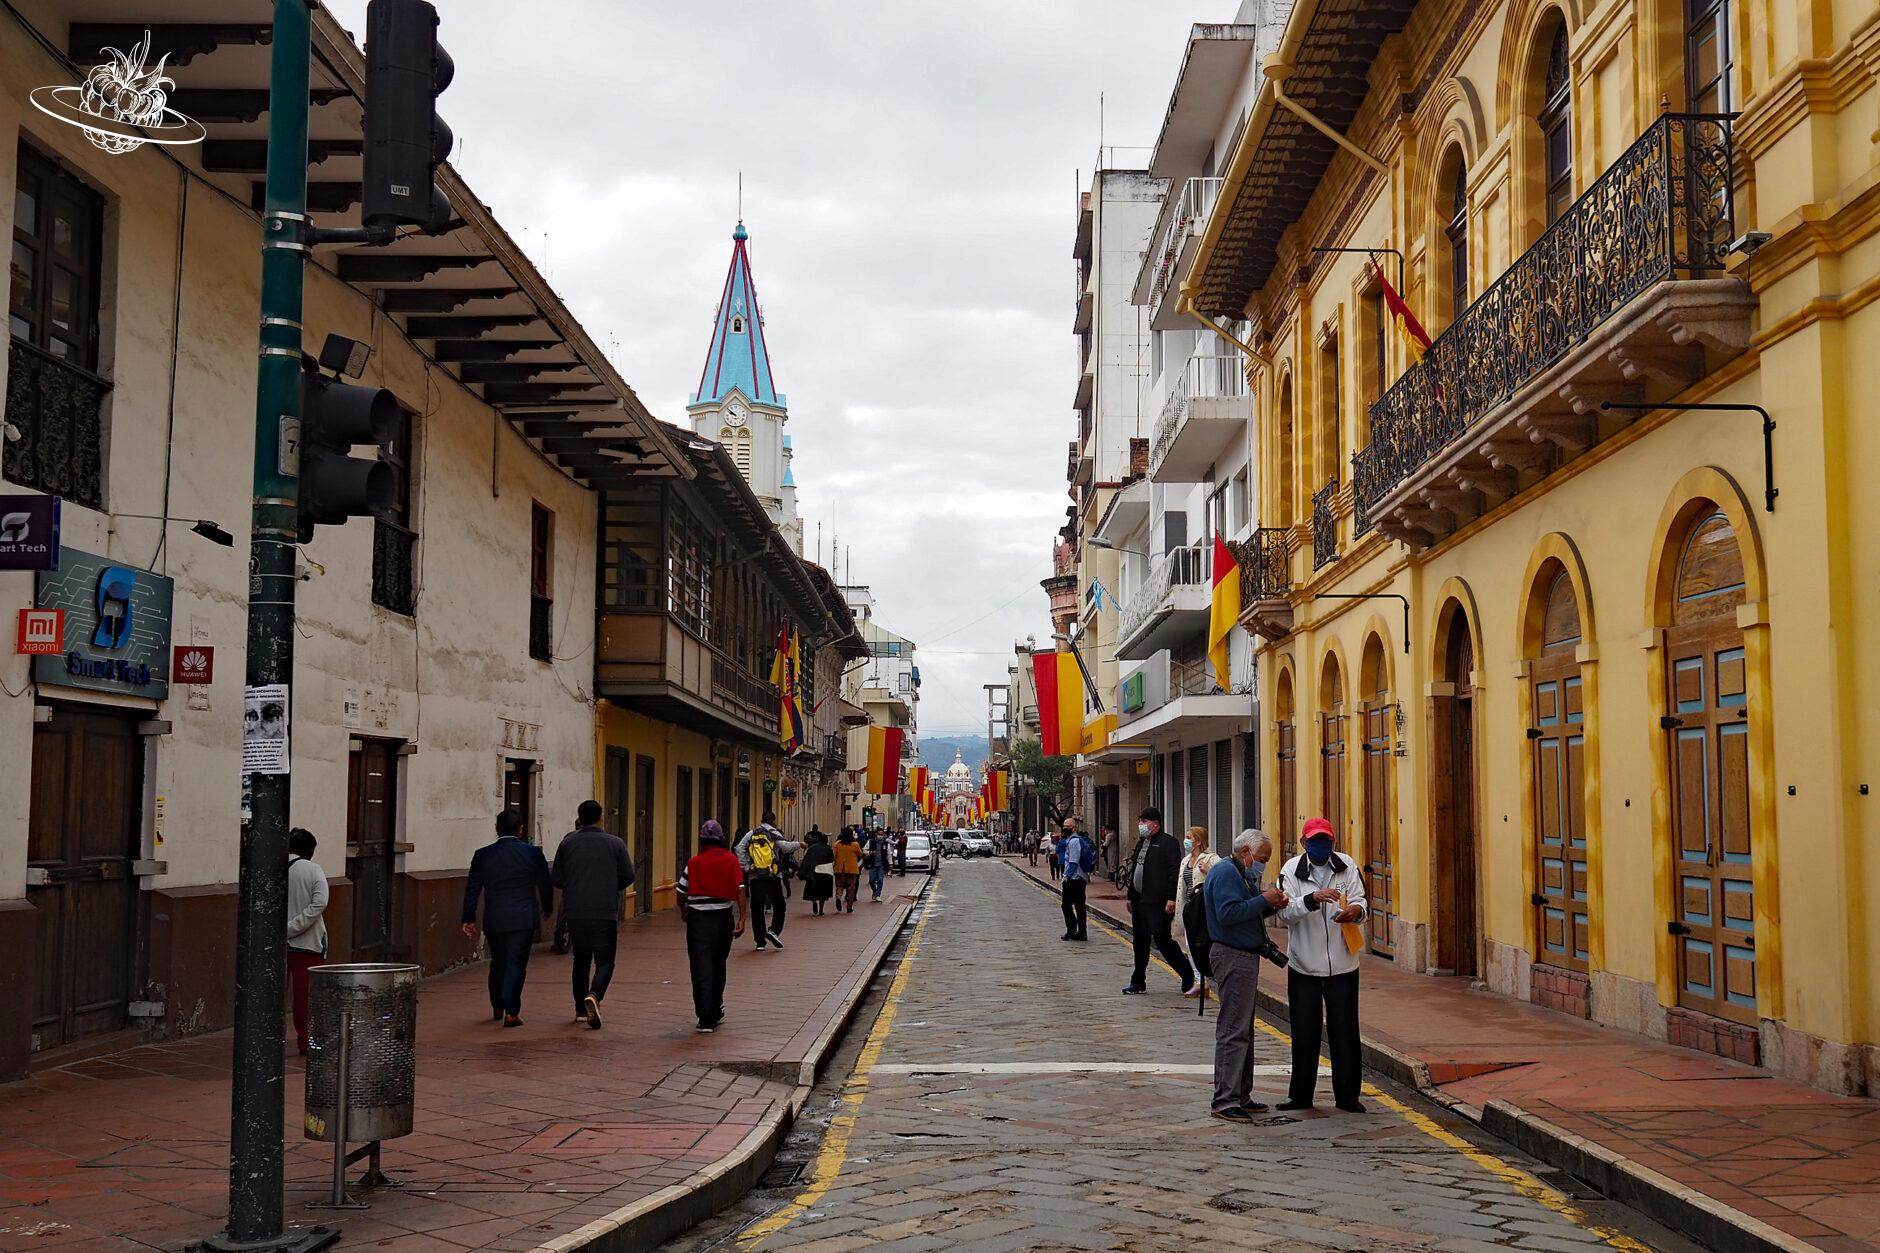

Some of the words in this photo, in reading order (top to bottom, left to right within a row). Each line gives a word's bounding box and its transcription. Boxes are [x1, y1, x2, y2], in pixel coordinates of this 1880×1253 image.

[392, 186, 408, 195] UMT
[19, 543, 47, 553] Tech
[68, 651, 115, 680] Smart
[115, 659, 150, 685] Tech
